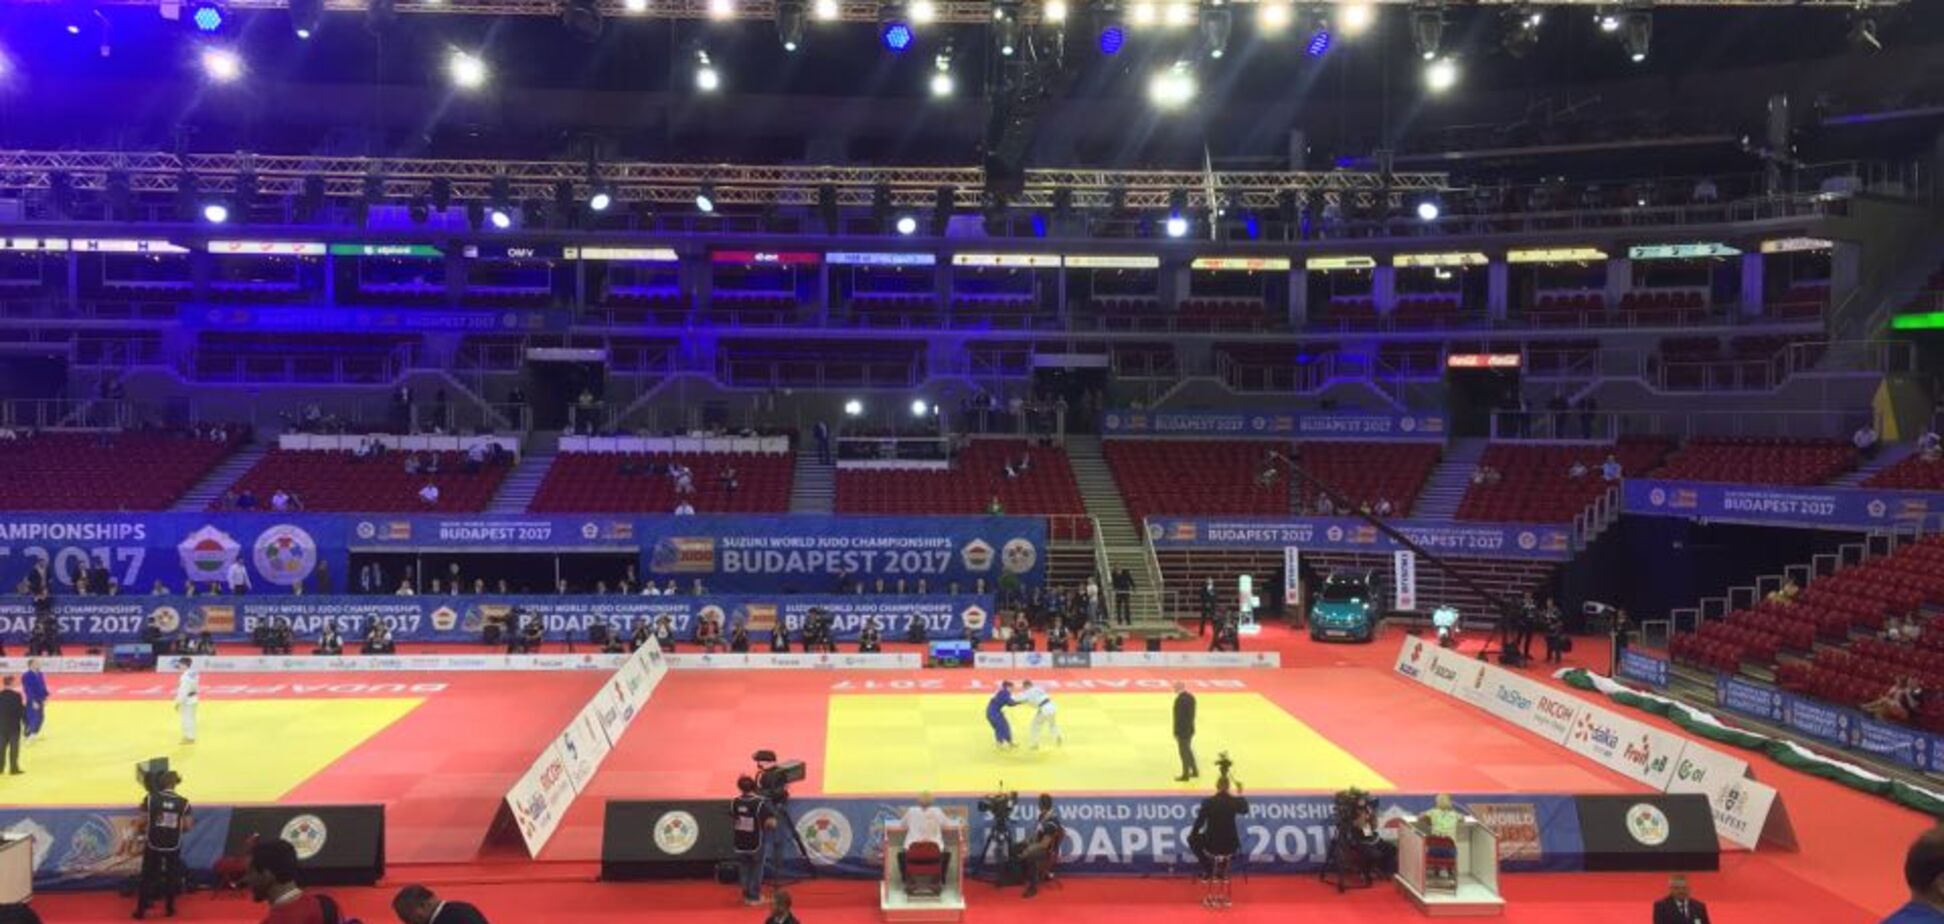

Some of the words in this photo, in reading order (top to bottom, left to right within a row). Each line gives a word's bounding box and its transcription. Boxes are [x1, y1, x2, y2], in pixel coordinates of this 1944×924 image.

[507, 247, 535, 258] OMV
[1724, 498, 1797, 513] BUDAPEST
[1801, 501, 1835, 515] 2017
[440, 527, 514, 540] BUDAPEST
[519, 527, 552, 540] 2017
[1208, 529, 1278, 542] BUDAPEST
[1281, 529, 1313, 543] 2017
[723, 537, 768, 548] SUZUKI
[770, 537, 814, 548] WORLD
[818, 537, 849, 548] JUDO
[852, 537, 953, 548] CHAMPIONSHIPS
[1469, 535, 1503, 549] 2017
[722, 550, 878, 573] BUDAPEST
[884, 550, 952, 573] 2017
[90, 616, 143, 632] 2017
[1536, 696, 1575, 721] RICOH
[1058, 804, 1130, 820] WORLD
[1136, 804, 1186, 821] JUDO
